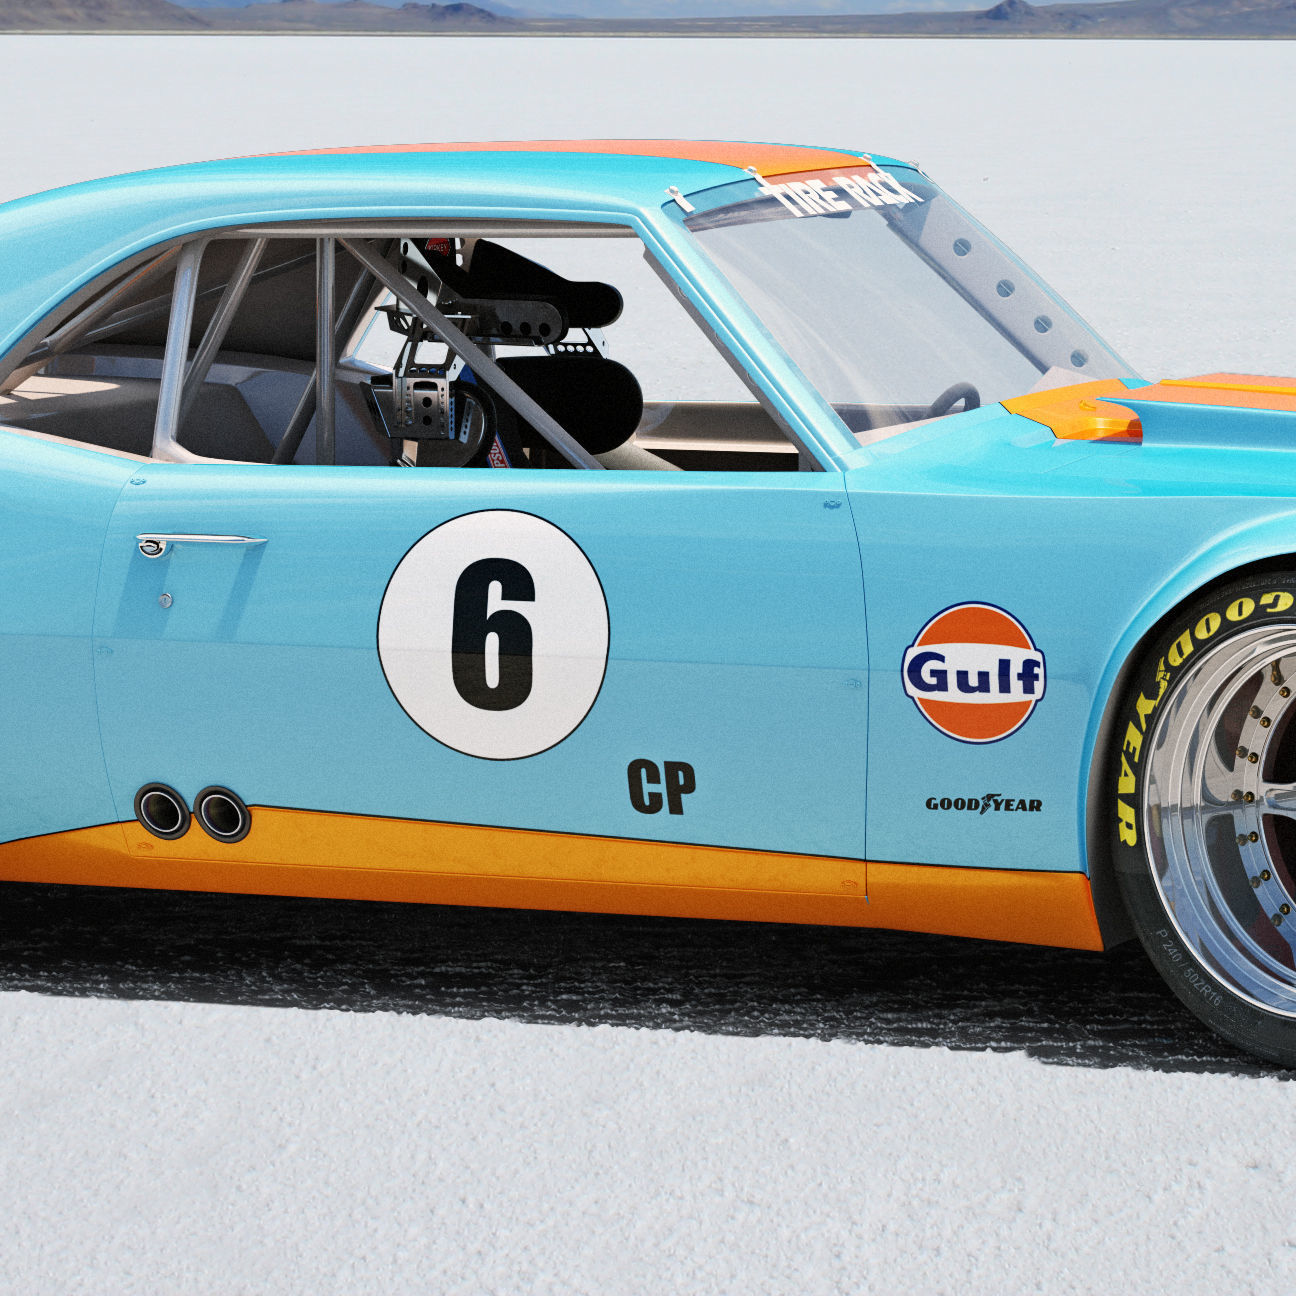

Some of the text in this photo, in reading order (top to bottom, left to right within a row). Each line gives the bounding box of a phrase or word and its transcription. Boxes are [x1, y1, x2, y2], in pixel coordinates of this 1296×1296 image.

[758, 172, 925, 217] TIRE RACK
[451, 557, 535, 711] 6
[907, 651, 1041, 695] Gulf
[1117, 591, 1294, 847] GOODYEAR
[627, 758, 696, 815] CP
[925, 793, 1043, 815] GOODYEAR
